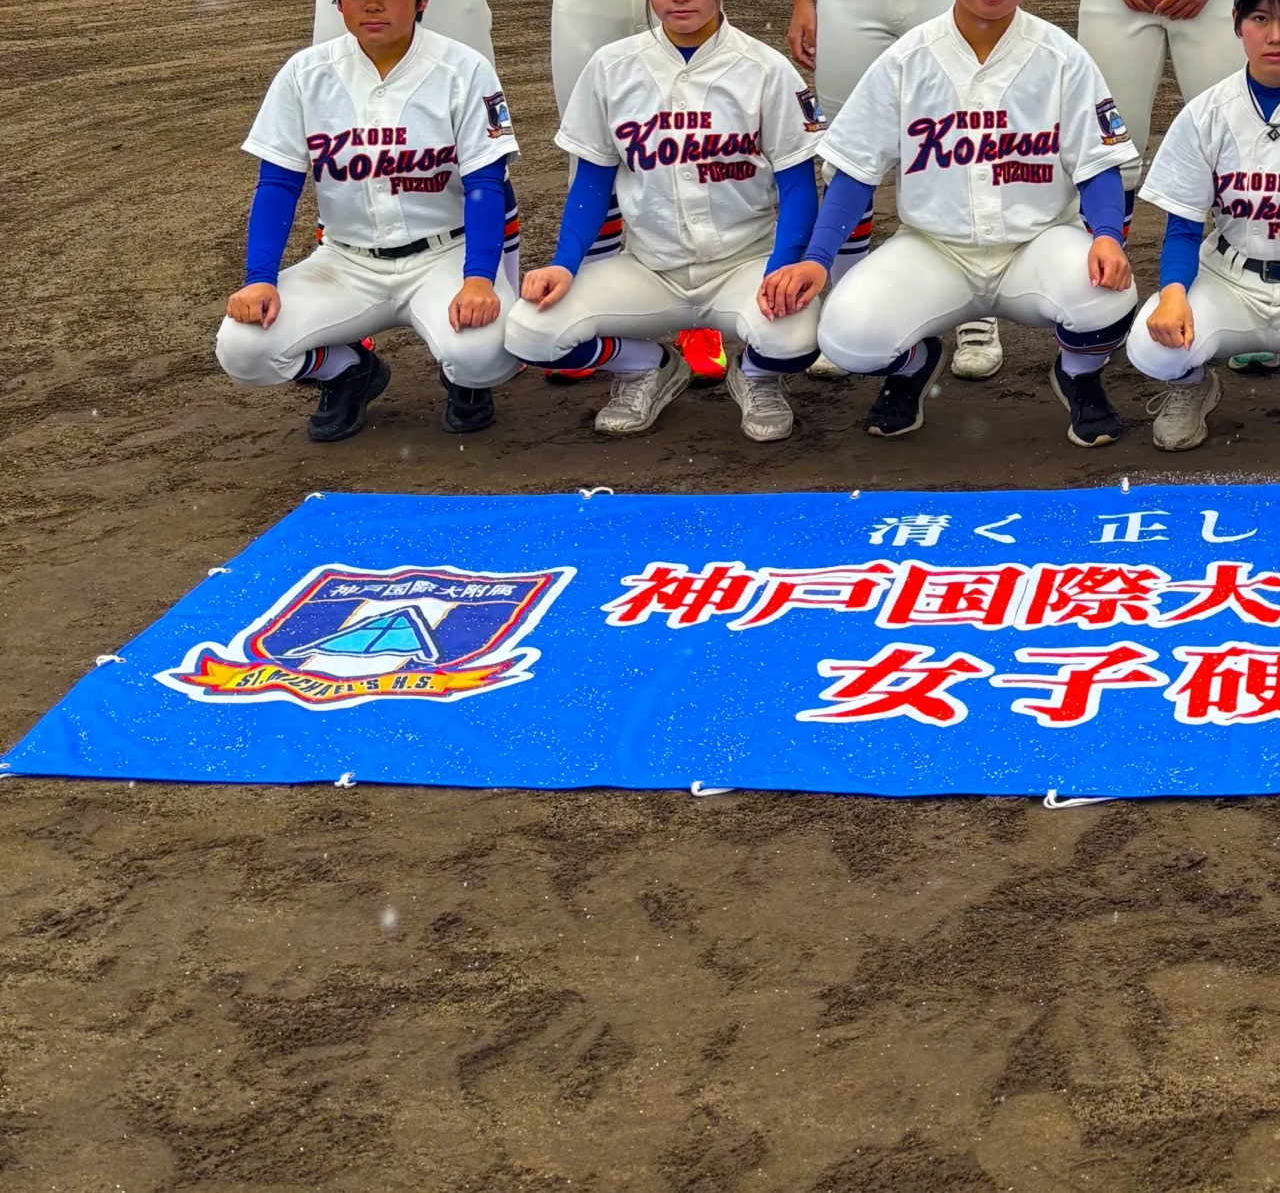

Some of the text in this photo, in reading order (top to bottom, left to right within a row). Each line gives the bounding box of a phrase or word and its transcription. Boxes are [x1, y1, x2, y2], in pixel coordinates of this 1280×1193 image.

[659, 111, 712, 130] KOBE
[956, 110, 1007, 129] KOBE
[351, 127, 407, 146] KOBE
[904, 113, 1060, 176] Kokusai
[307, 130, 458, 183] Kokusa
[992, 161, 1054, 186] FUZOKU
[868, 512, 1022, 546] 清く
[329, 579, 518, 598] 神戸国際大附属
